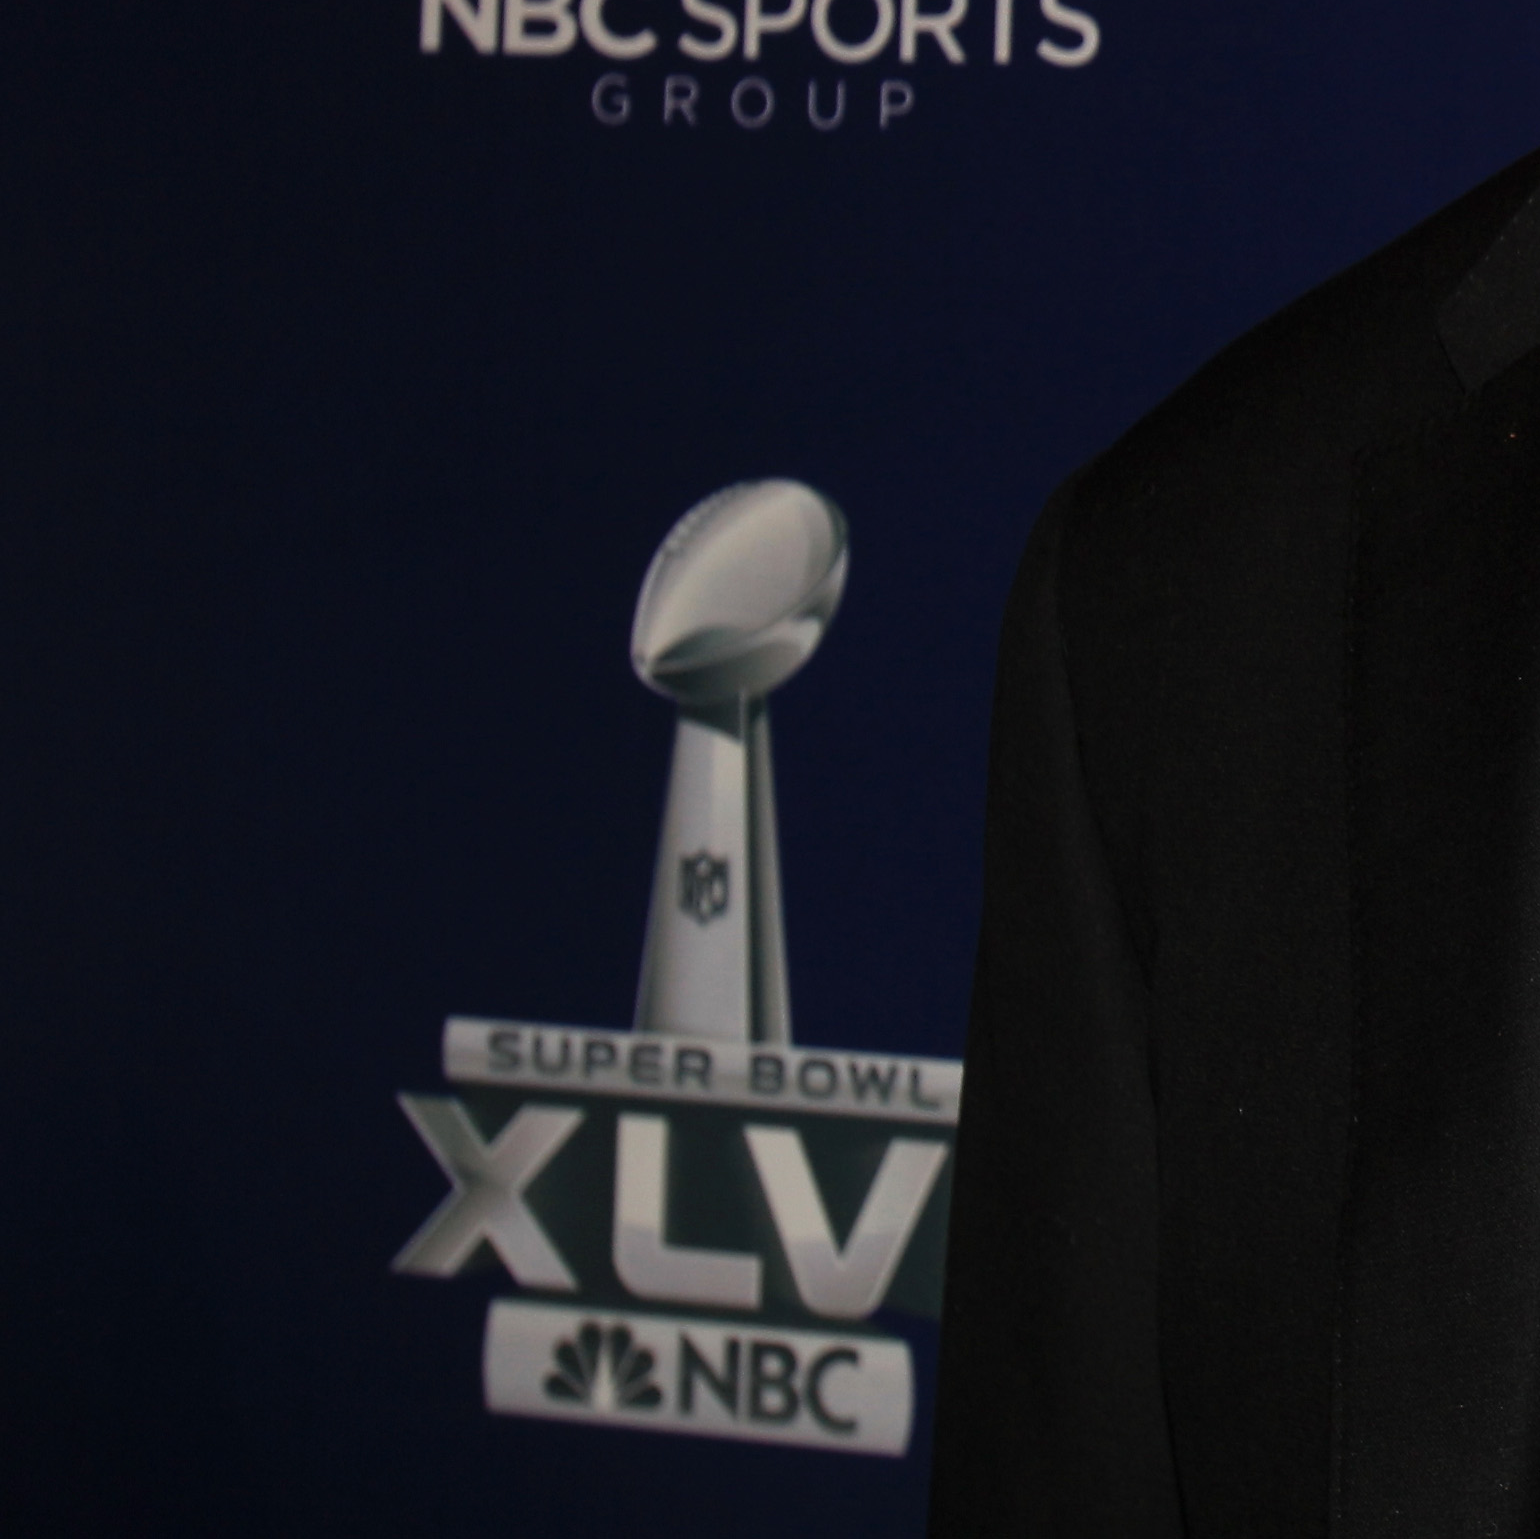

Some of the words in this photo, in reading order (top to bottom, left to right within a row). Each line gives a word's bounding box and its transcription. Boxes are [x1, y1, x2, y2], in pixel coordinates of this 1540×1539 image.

[591, 73, 914, 129] GROUP
[487, 1030, 713, 1088] SUPER
[749, 1056, 942, 1110] BOWL
[392, 1092, 950, 1320] XLV
[678, 1332, 860, 1436] NBC
